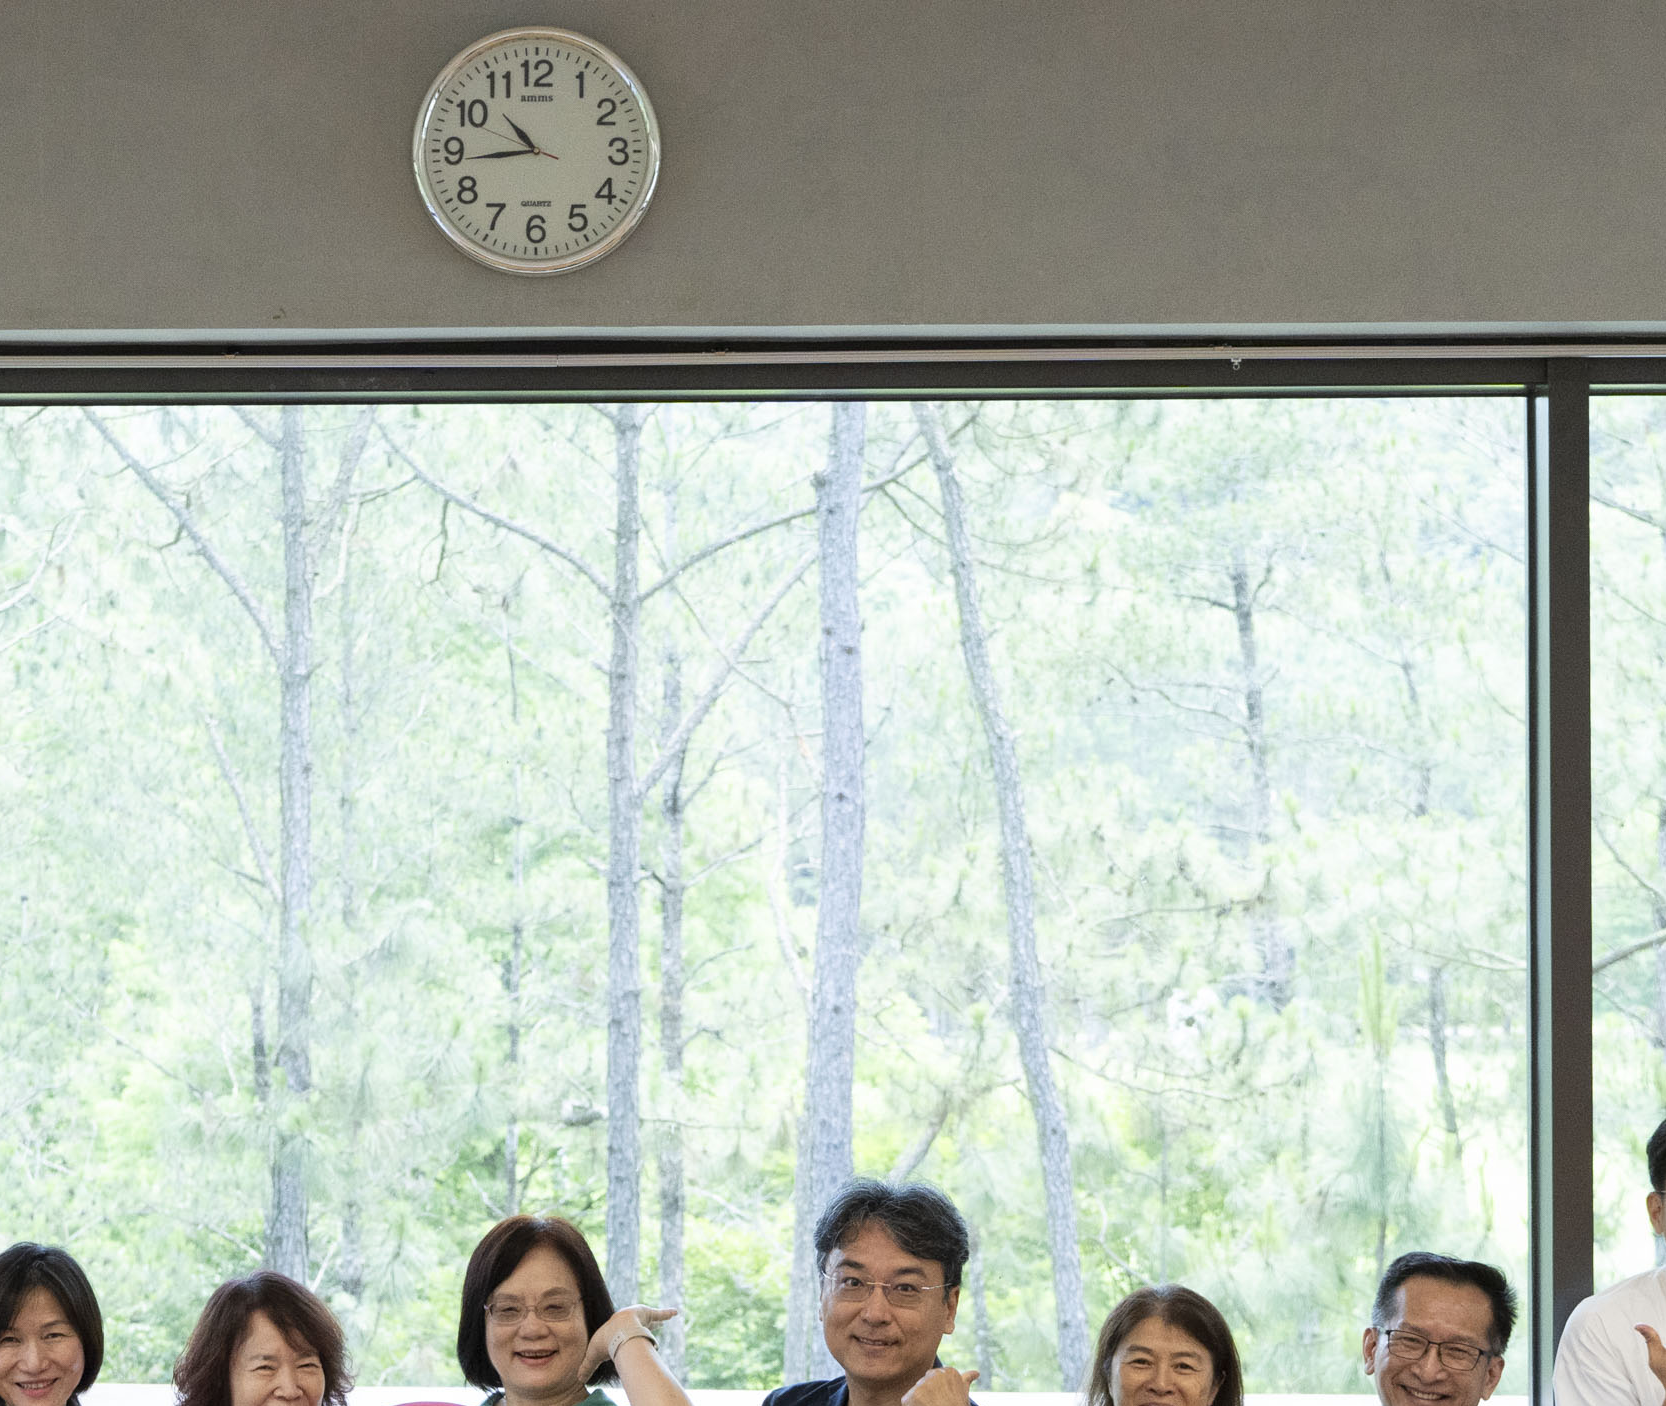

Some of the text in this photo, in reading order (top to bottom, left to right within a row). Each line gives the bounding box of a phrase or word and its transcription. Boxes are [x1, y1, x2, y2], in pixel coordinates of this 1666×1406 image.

[486, 70, 511, 99] 11
[520, 59, 554, 88] 12
[575, 71, 585, 99] 1
[456, 99, 488, 128] 10
[596, 98, 617, 126] 2
[443, 136, 464, 165] 9
[607, 137, 630, 166] 3
[457, 175, 478, 204] 8
[520, 200, 552, 208] QUARTZ
[595, 177, 617, 205] 4
[486, 203, 506, 231] 7
[525, 214, 546, 243] 6
[567, 204, 588, 232] 5
